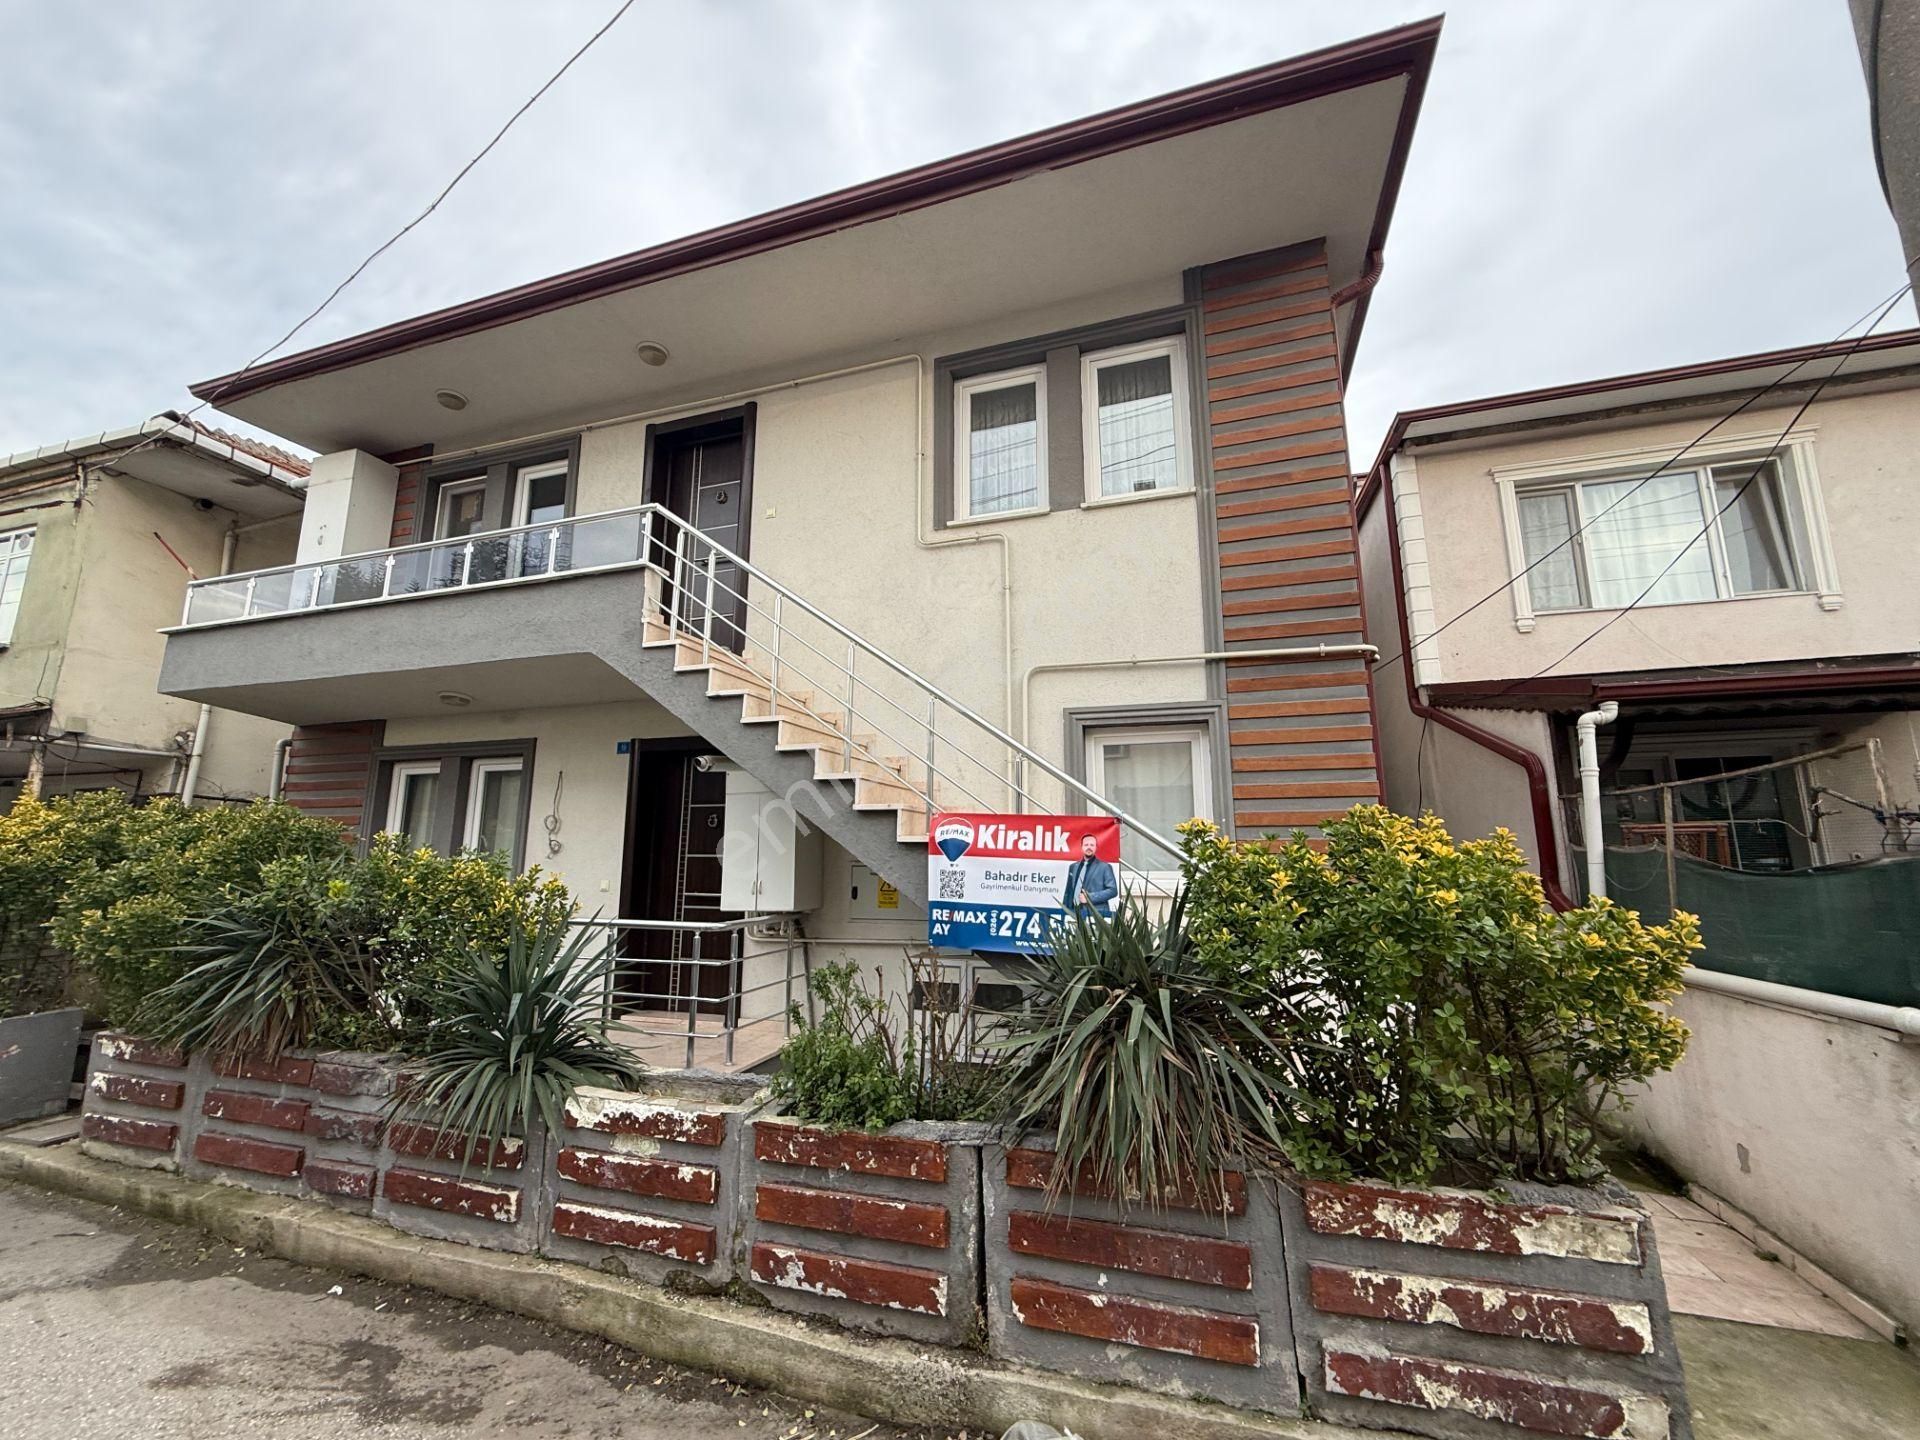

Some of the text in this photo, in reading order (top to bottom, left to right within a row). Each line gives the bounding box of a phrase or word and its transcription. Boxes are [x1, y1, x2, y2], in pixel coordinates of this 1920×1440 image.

[940, 828, 970, 837] RE/MAX
[977, 824, 1070, 853] Kiralık
[984, 870, 1056, 884] Bahadır Eker
[980, 882, 1059, 894] Gayrimenkul Danışmanı
[932, 908, 987, 924] RE/MAX
[932, 922, 951, 935] AY
[998, 910, 1041, 938] 274
